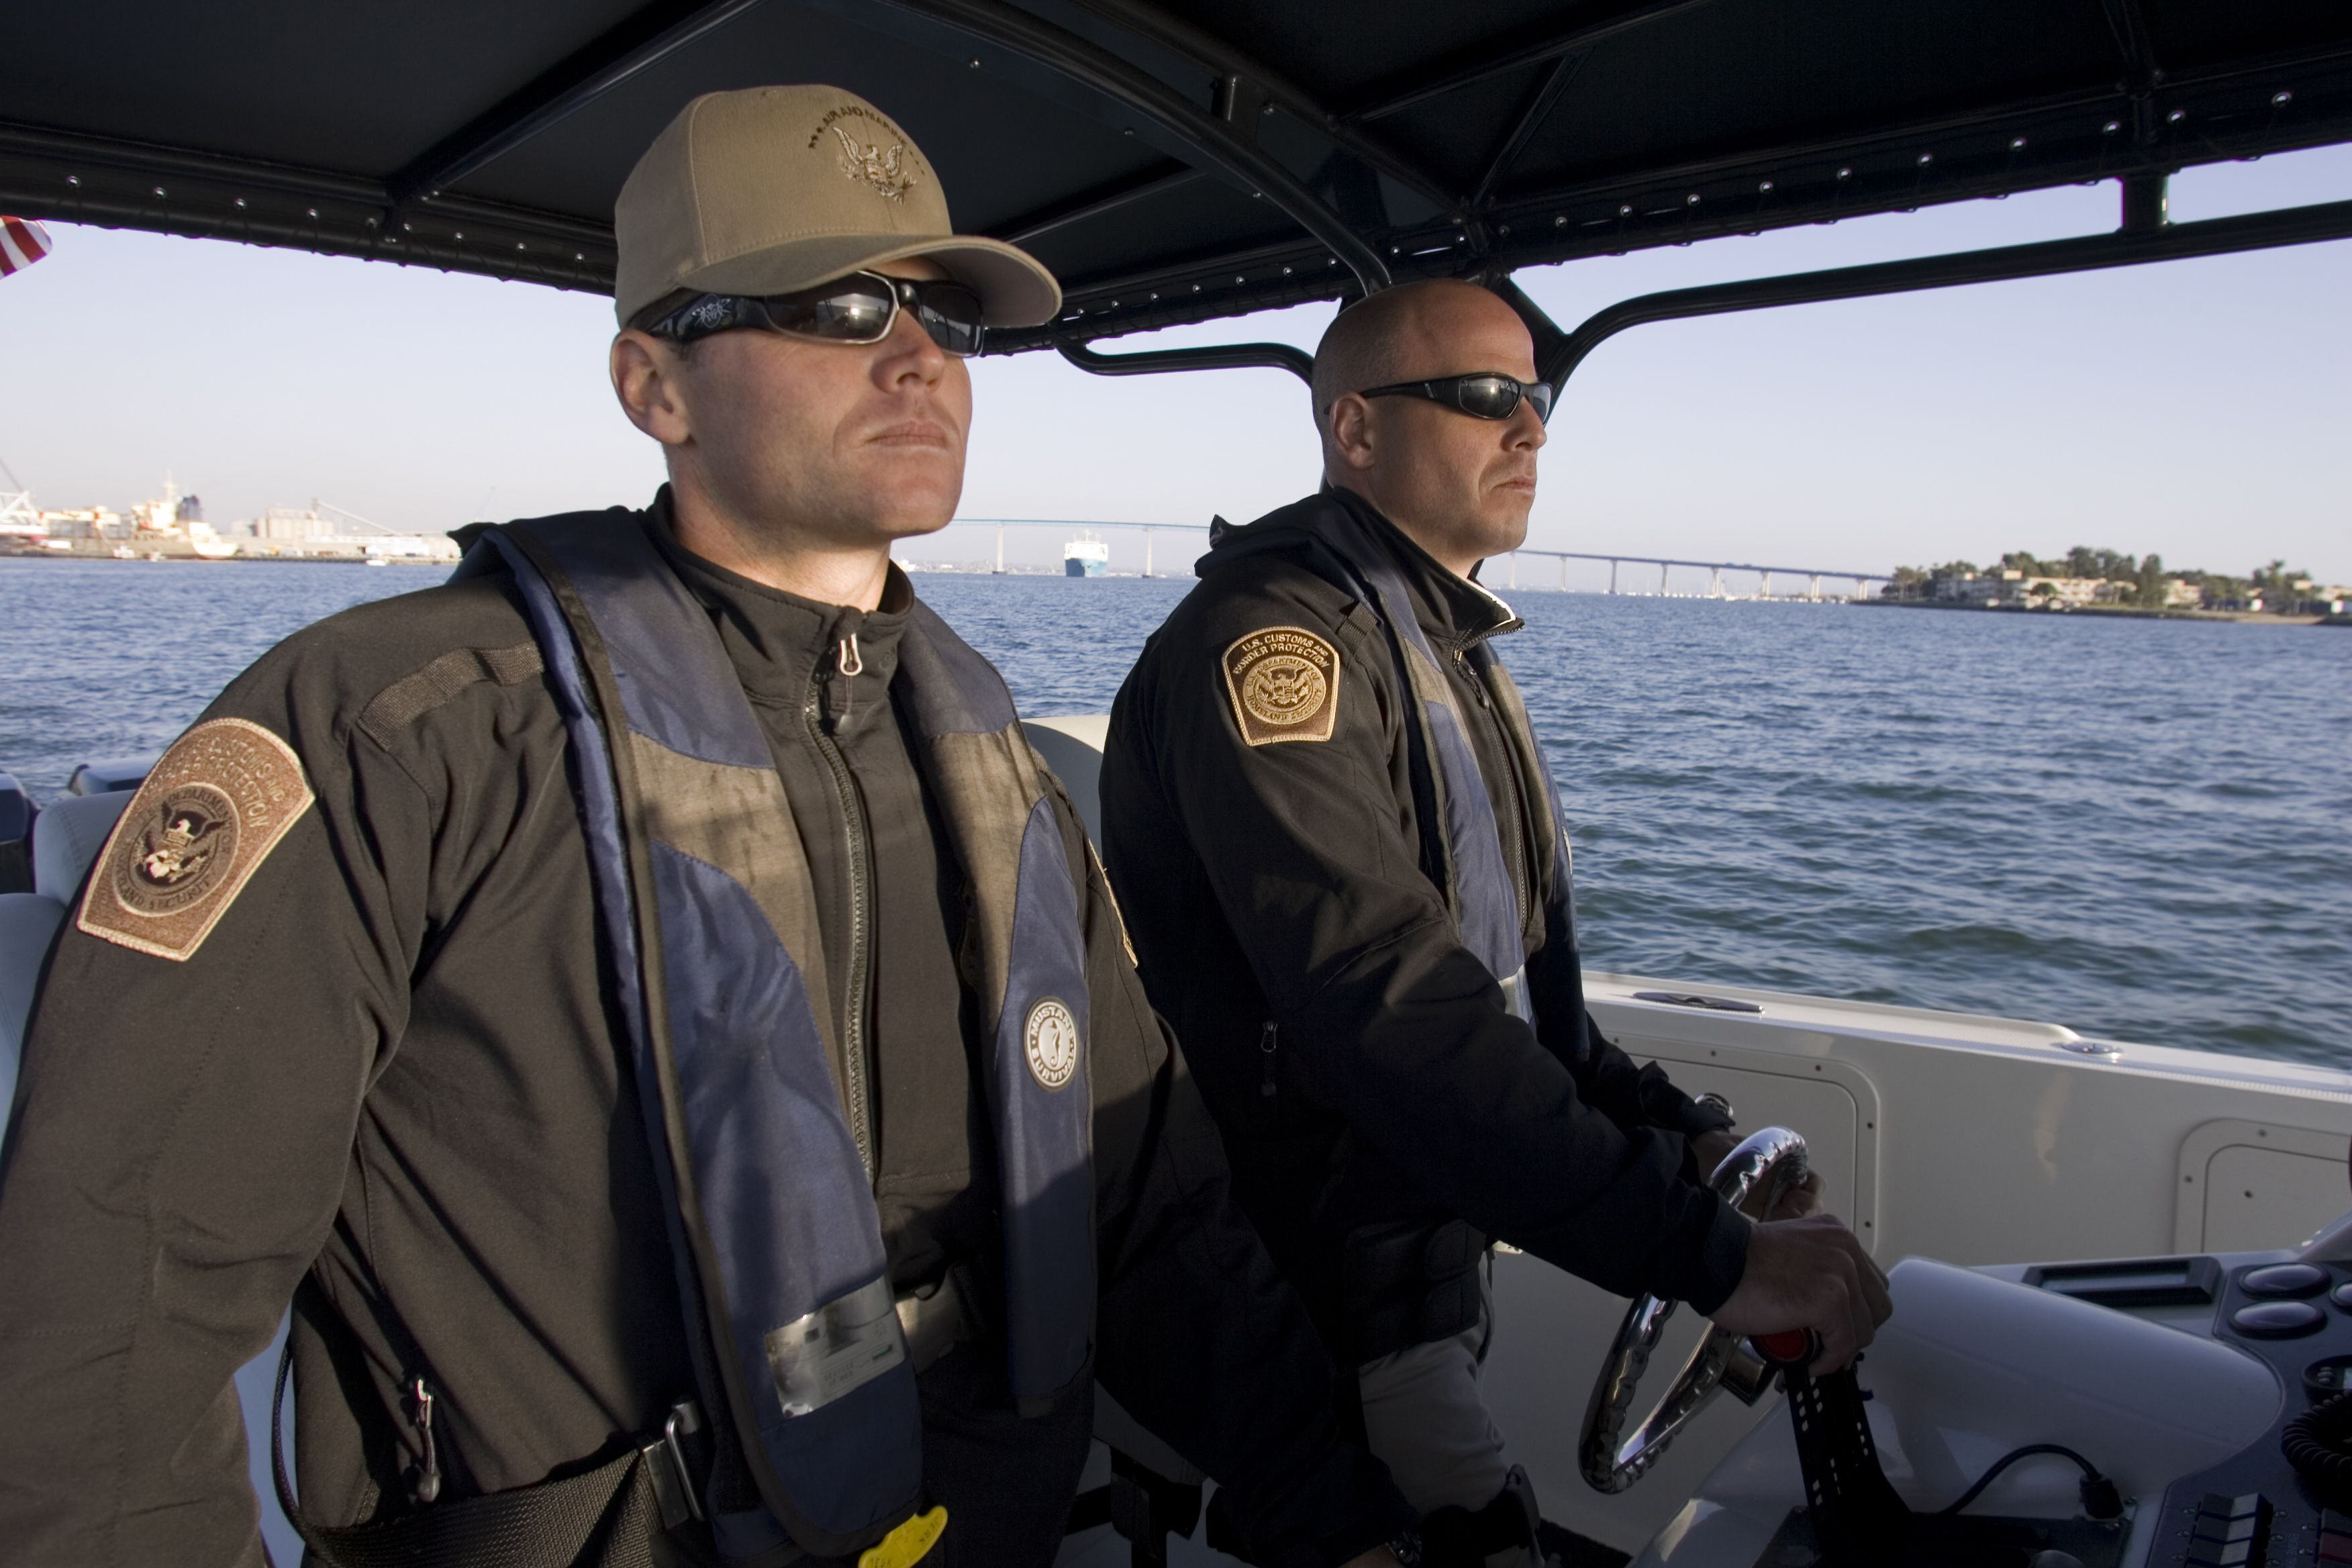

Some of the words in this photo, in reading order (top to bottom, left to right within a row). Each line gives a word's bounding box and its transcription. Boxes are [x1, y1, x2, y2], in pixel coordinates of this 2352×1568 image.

[823, 110, 841, 126] AIR
[840, 106, 863, 117] AND
[865, 109, 907, 145] MARINE
[1233, 646, 1268, 675] BORDER
[1270, 643, 1330, 668] PROTECTION
[1242, 638, 1263, 652] U.S.
[1265, 634, 1314, 647] CUSTOMS
[1313, 645, 1328, 656] AND
[1030, 1006, 1074, 1040] MUSTANG
[1031, 1048, 1074, 1082] SURVIVAL
